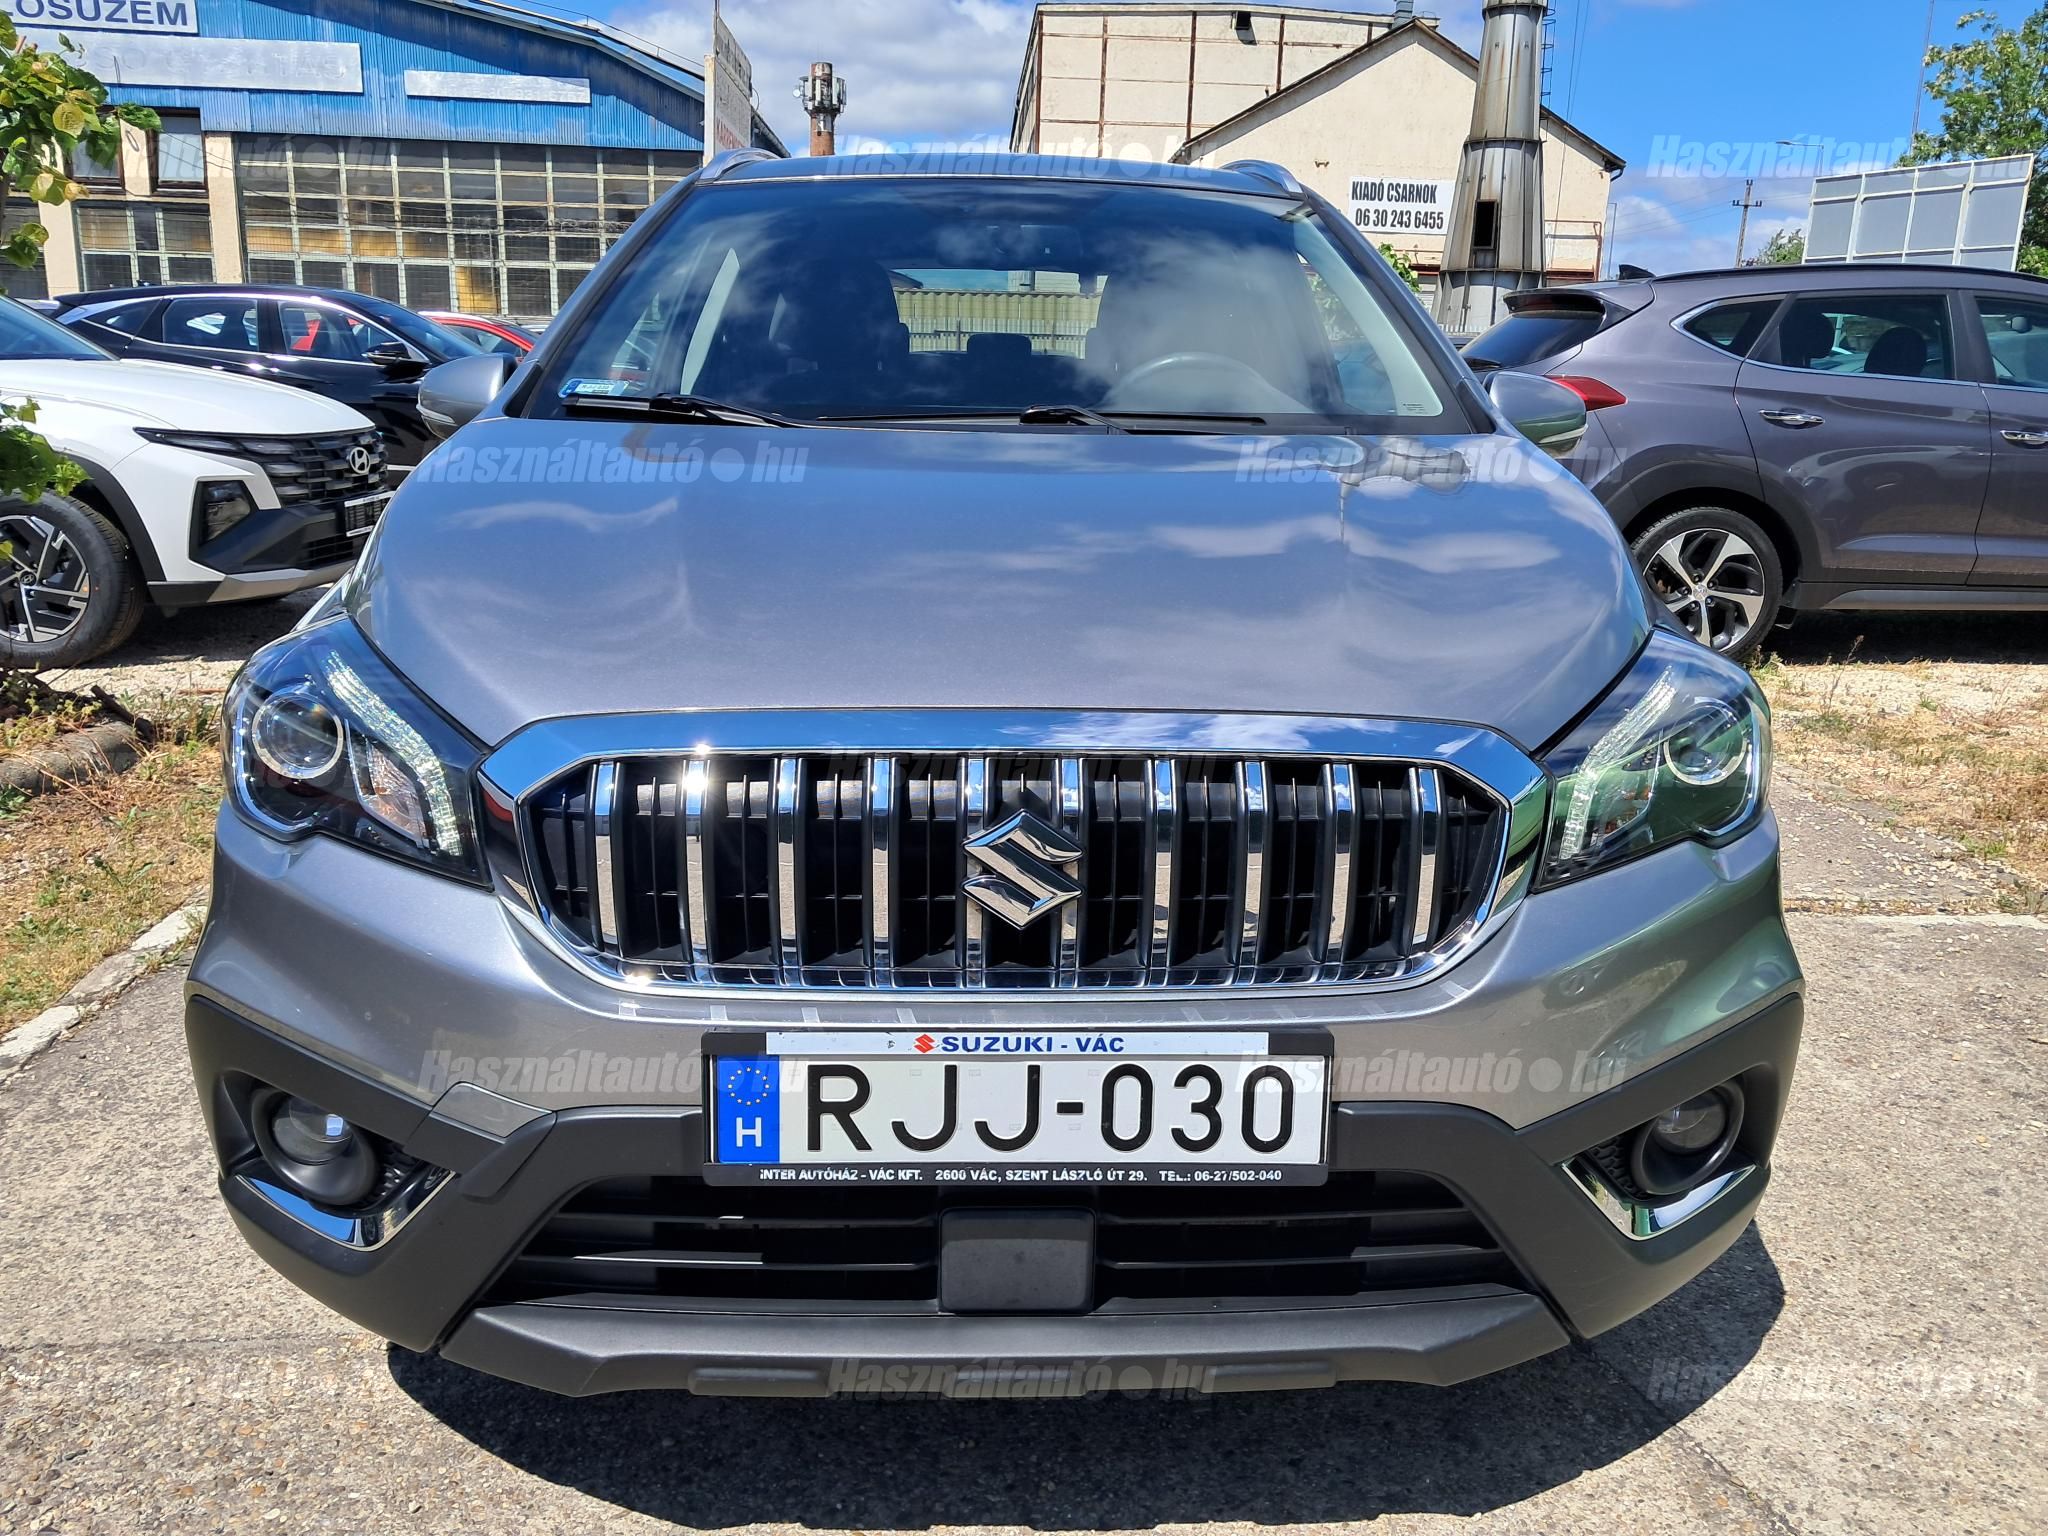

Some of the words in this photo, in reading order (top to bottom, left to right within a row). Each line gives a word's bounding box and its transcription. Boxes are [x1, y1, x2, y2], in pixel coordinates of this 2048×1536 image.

[3, 0, 188, 26] OSUZEM
[1351, 178, 1385, 201] KIADÓ
[1387, 182, 1438, 204] CSARNOK
[1355, 208, 1371, 226] 06
[1373, 209, 1388, 227] 30
[1390, 210, 1412, 228] 243
[1414, 211, 1444, 229] 6455
[941, 1035, 1053, 1053] SUZUKI
[1075, 1033, 1125, 1053] VÁC
[806, 1063, 1296, 1153] RJJ-030
[736, 1117, 762, 1148] H
[798, 1167, 858, 1180] AUTÓHÁZ
[869, 1167, 895, 1180] VÁC
[898, 1169, 923, 1181] KFT.
[935, 1169, 967, 1181] 2600
[970, 1167, 1002, 1183] VÁC,
[1005, 1170, 1049, 1181] SZENT
[1052, 1168, 1103, 1181] LÁSZLÓ
[1106, 1169, 1125, 1181] ÚT
[1128, 1171, 1148, 1181] 29.
[1159, 1170, 1191, 1182] TEL.:
[1194, 1170, 1282, 1182] 06-27/502-040
